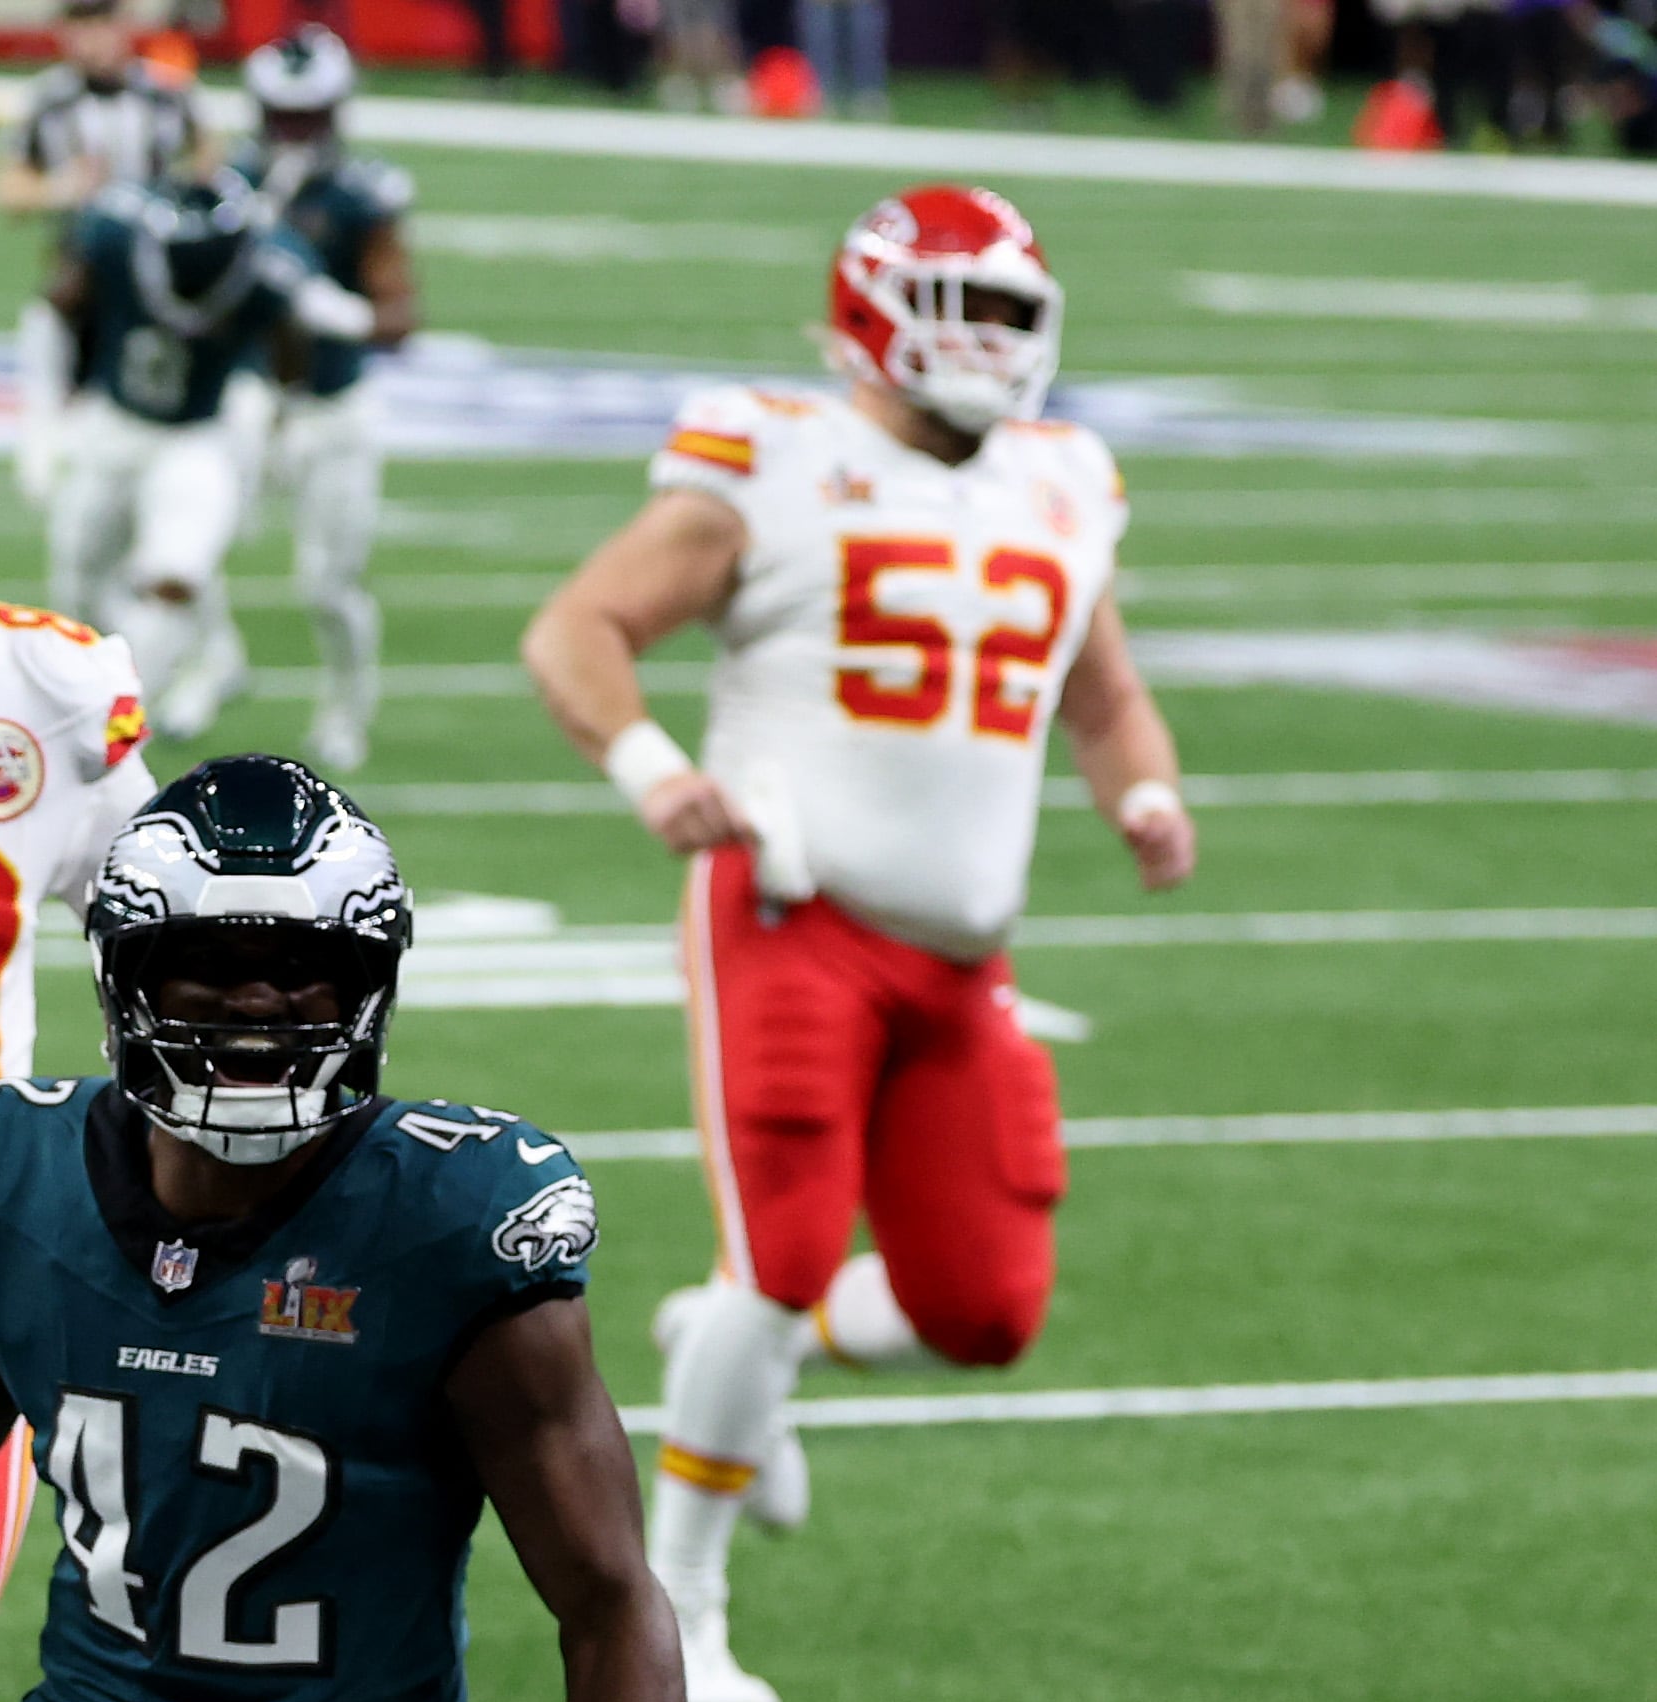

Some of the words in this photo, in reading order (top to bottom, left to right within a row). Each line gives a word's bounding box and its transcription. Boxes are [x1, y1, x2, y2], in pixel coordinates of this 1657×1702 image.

[837, 535, 1072, 744] 52
[117, 1346, 220, 1377] EAGLES
[262, 1281, 361, 1332] LIX
[47, 1389, 335, 1669] 42
